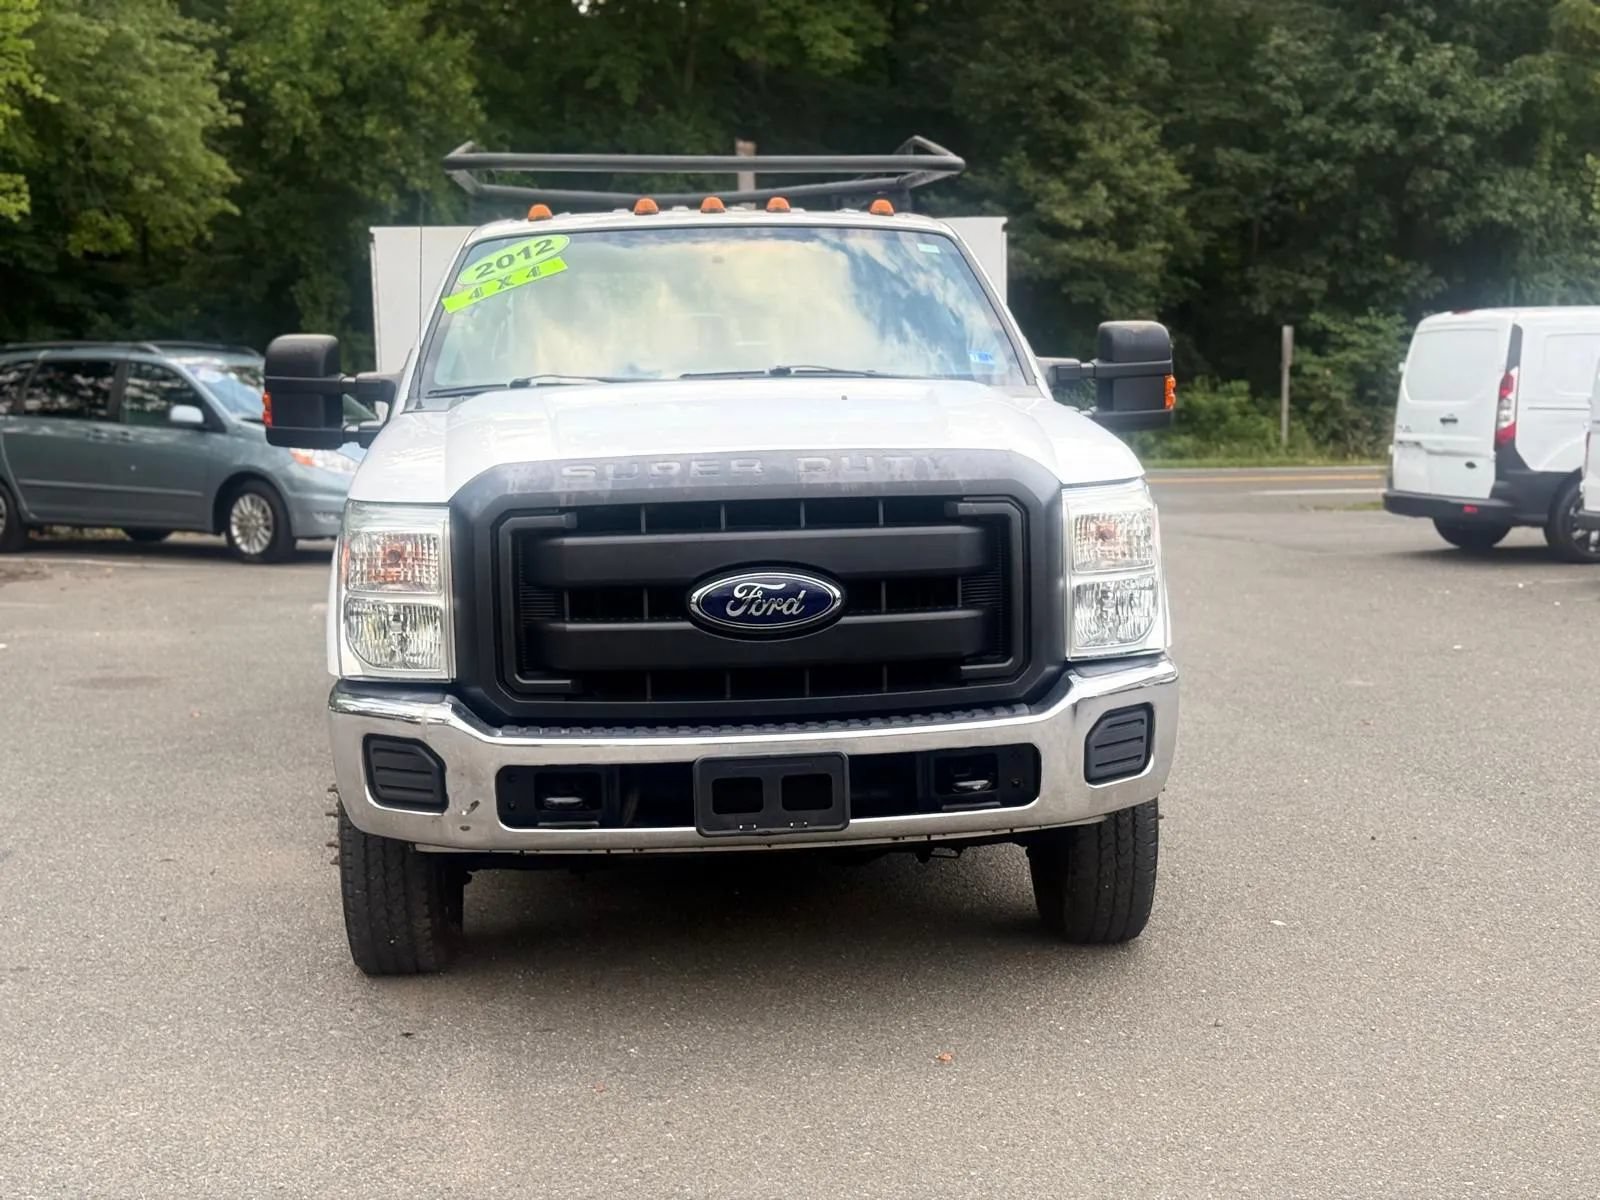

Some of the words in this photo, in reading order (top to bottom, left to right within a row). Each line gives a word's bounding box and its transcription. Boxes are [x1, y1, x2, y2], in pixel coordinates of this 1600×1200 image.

[475, 239, 555, 279] 2012
[468, 287, 484, 300] 4
[526, 266, 542, 279] 4
[561, 458, 764, 482] SUPER
[796, 456, 954, 480] DUTY
[725, 582, 806, 617] Ford
